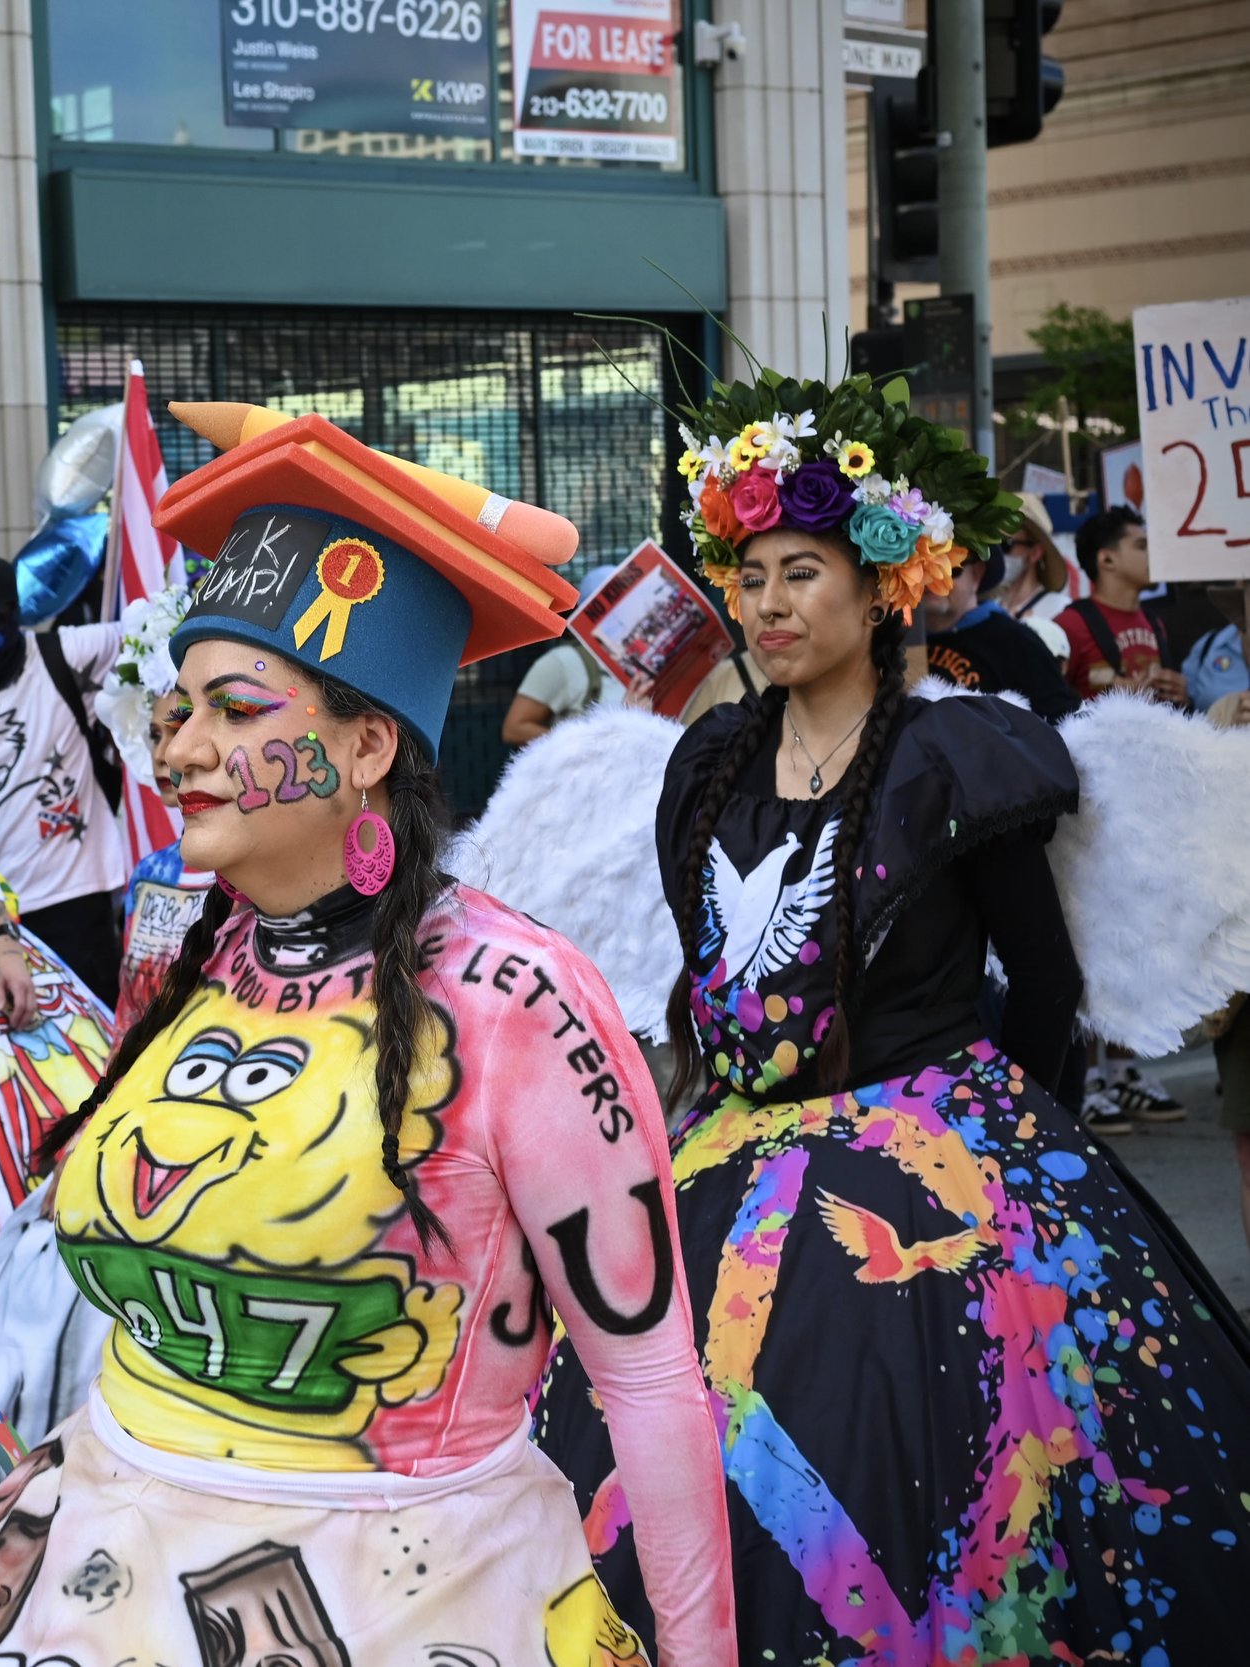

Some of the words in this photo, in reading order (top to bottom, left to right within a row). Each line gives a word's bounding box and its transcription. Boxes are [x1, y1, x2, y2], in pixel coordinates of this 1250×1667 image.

[230, 0, 483, 42] 310-887-6226
[232, 38, 276, 57] Justin
[276, 41, 319, 60] Weiss
[541, 22, 593, 61] FOR
[599, 26, 665, 66] LEASE
[881, 50, 917, 71] WAY
[232, 80, 261, 99] Lee
[263, 81, 316, 102] Shapiro
[436, 80, 487, 104] KWP
[1141, 337, 1250, 411] INV
[1201, 395, 1250, 430] Th
[336, 554, 362, 589] 1
[584, 599, 606, 622] NO
[602, 561, 644, 603] KINGS
[225, 736, 341, 816] 123
[231, 963, 269, 1009] YOU
[276, 975, 333, 1014] BY
[344, 933, 445, 999] TE
[461, 943, 634, 1144] LETTERS
[546, 1177, 674, 1336] U
